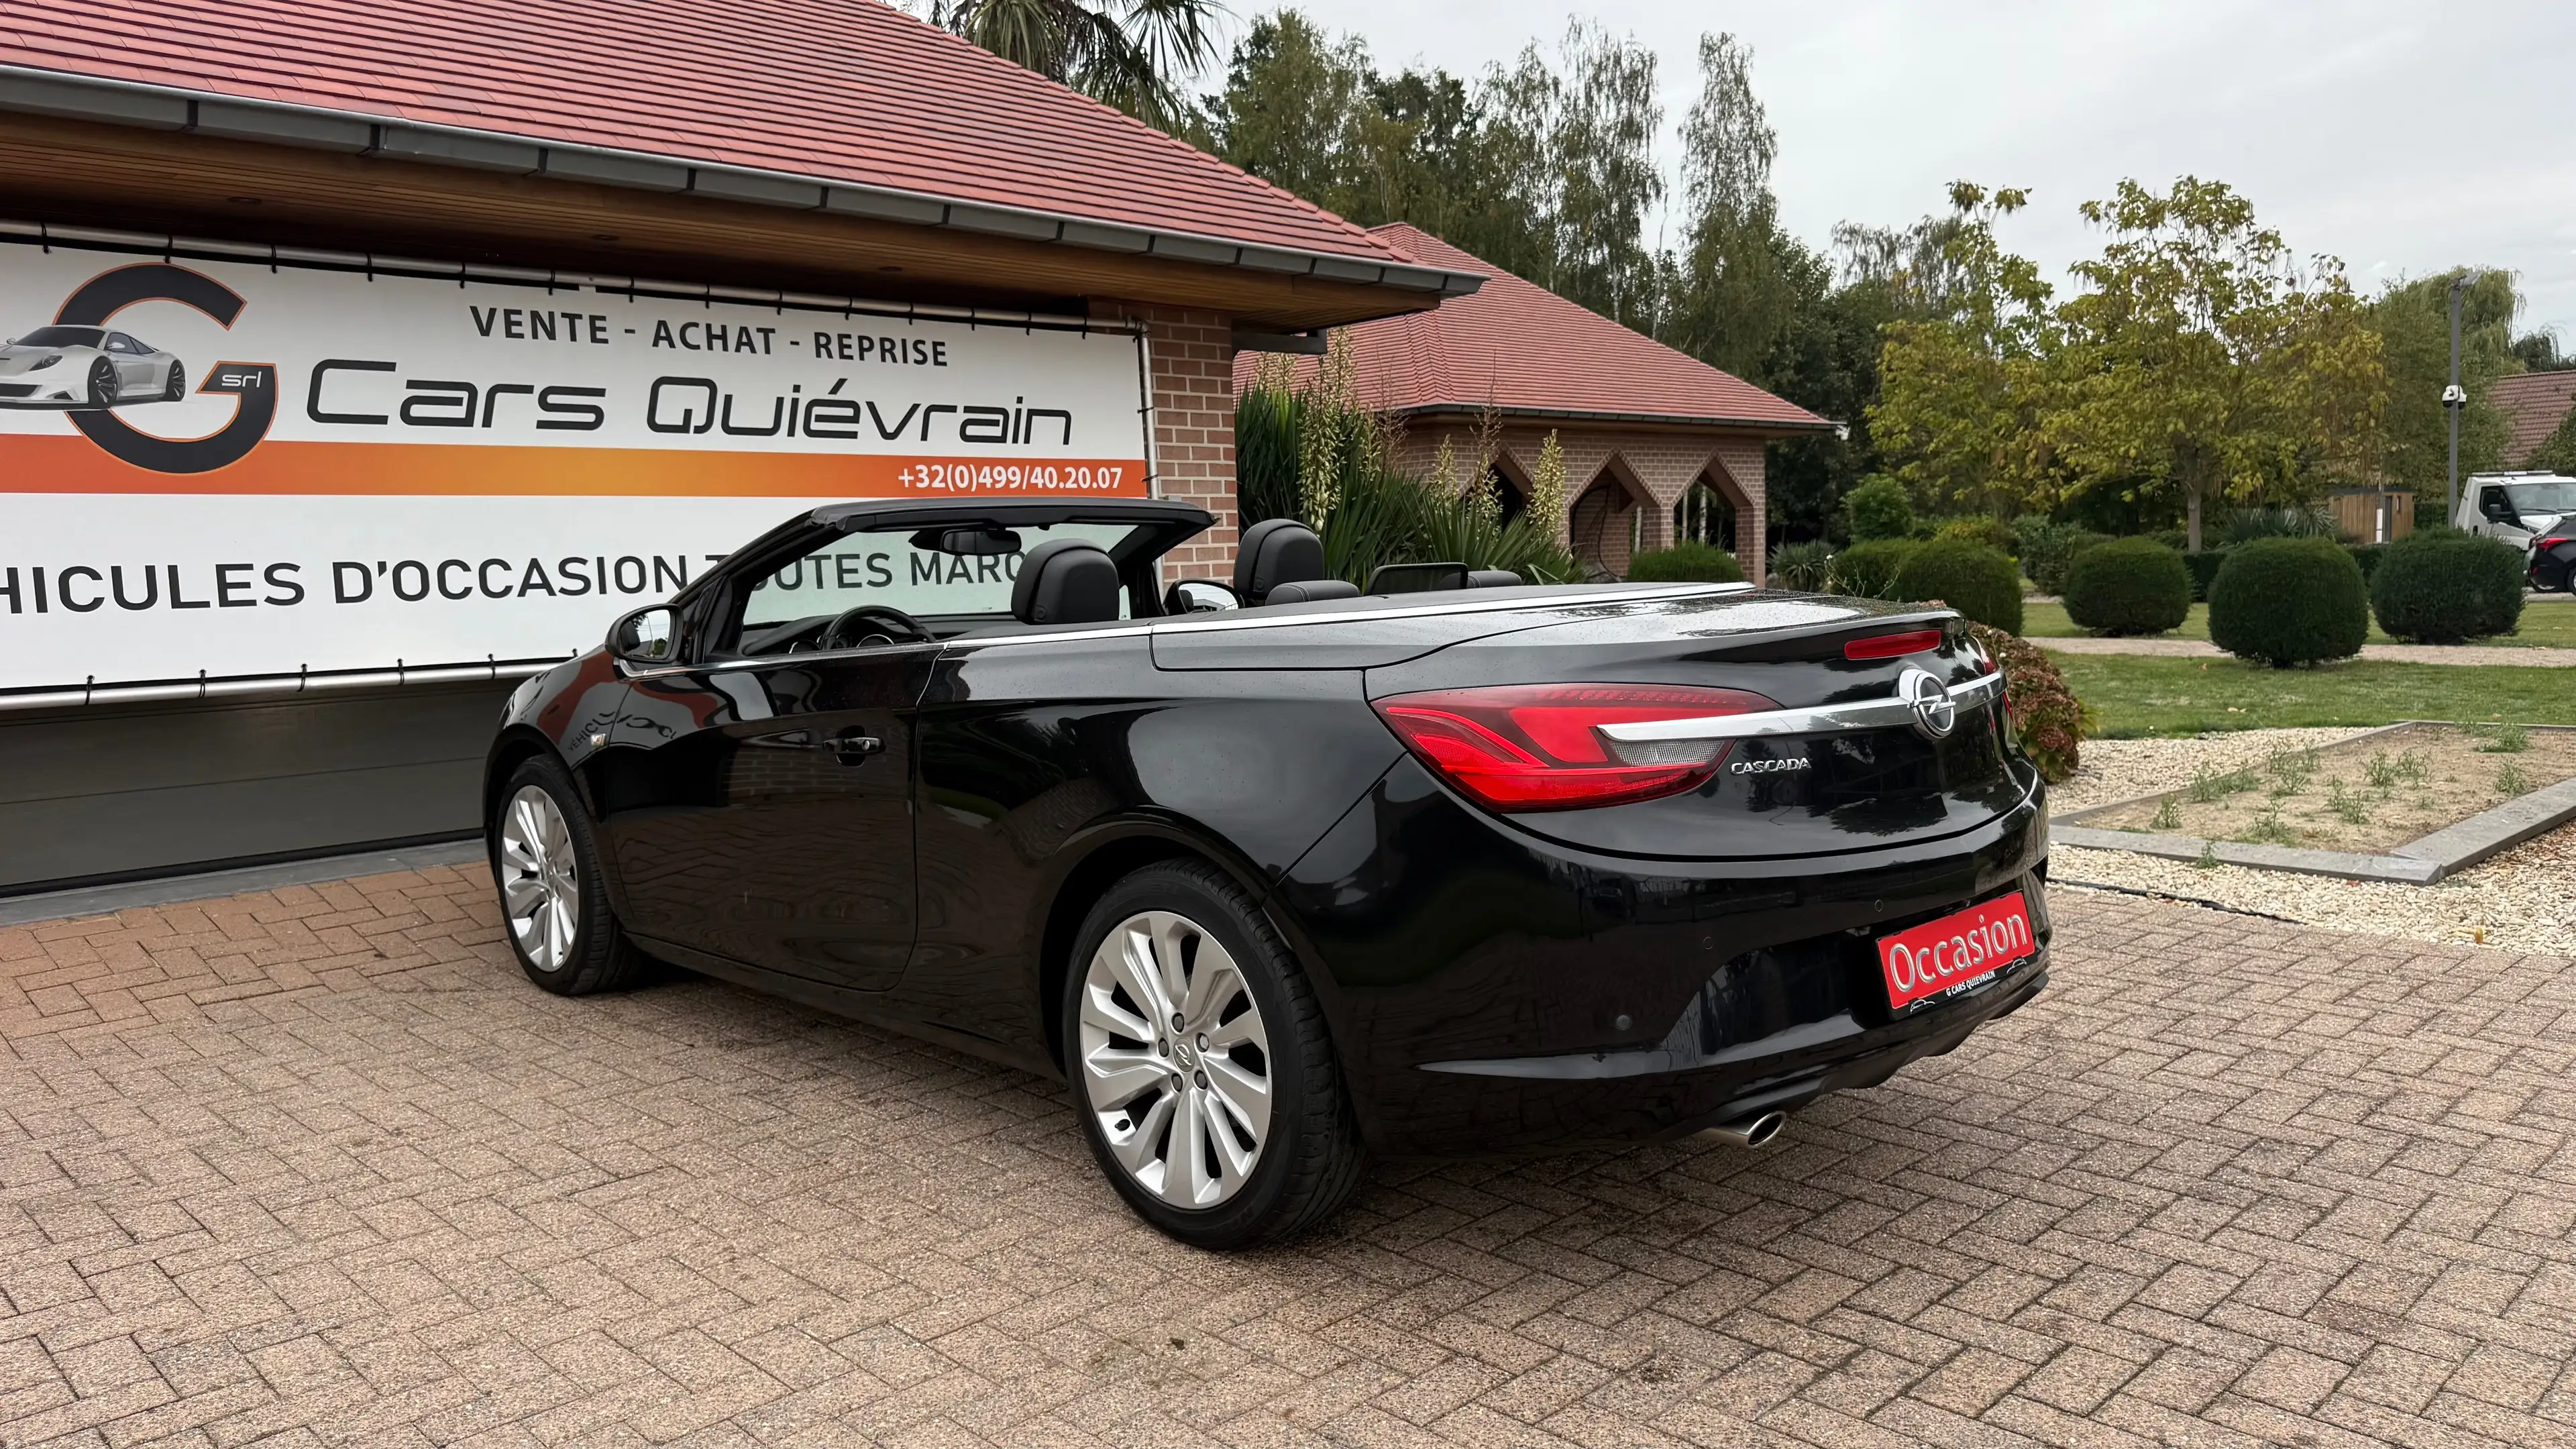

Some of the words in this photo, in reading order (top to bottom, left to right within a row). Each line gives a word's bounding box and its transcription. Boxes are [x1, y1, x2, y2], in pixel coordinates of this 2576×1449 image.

[469, 305, 609, 345] VENTE
[651, 318, 776, 355] ACHAT
[814, 331, 948, 367] REPRISE
[221, 371, 262, 388] srl
[307, 358, 606, 431] Cars
[647, 376, 1072, 445] Quiévrain
[898, 464, 1123, 492] +32(0)499/40.20.07
[332, 555, 688, 604] D'OCCASION
[1730, 757, 1813, 775] CASCADA
[1889, 913, 2028, 994] Occasion
[1951, 981, 1967, 994] CARS
[1966, 970, 1996, 989] QUIEVRAIN
